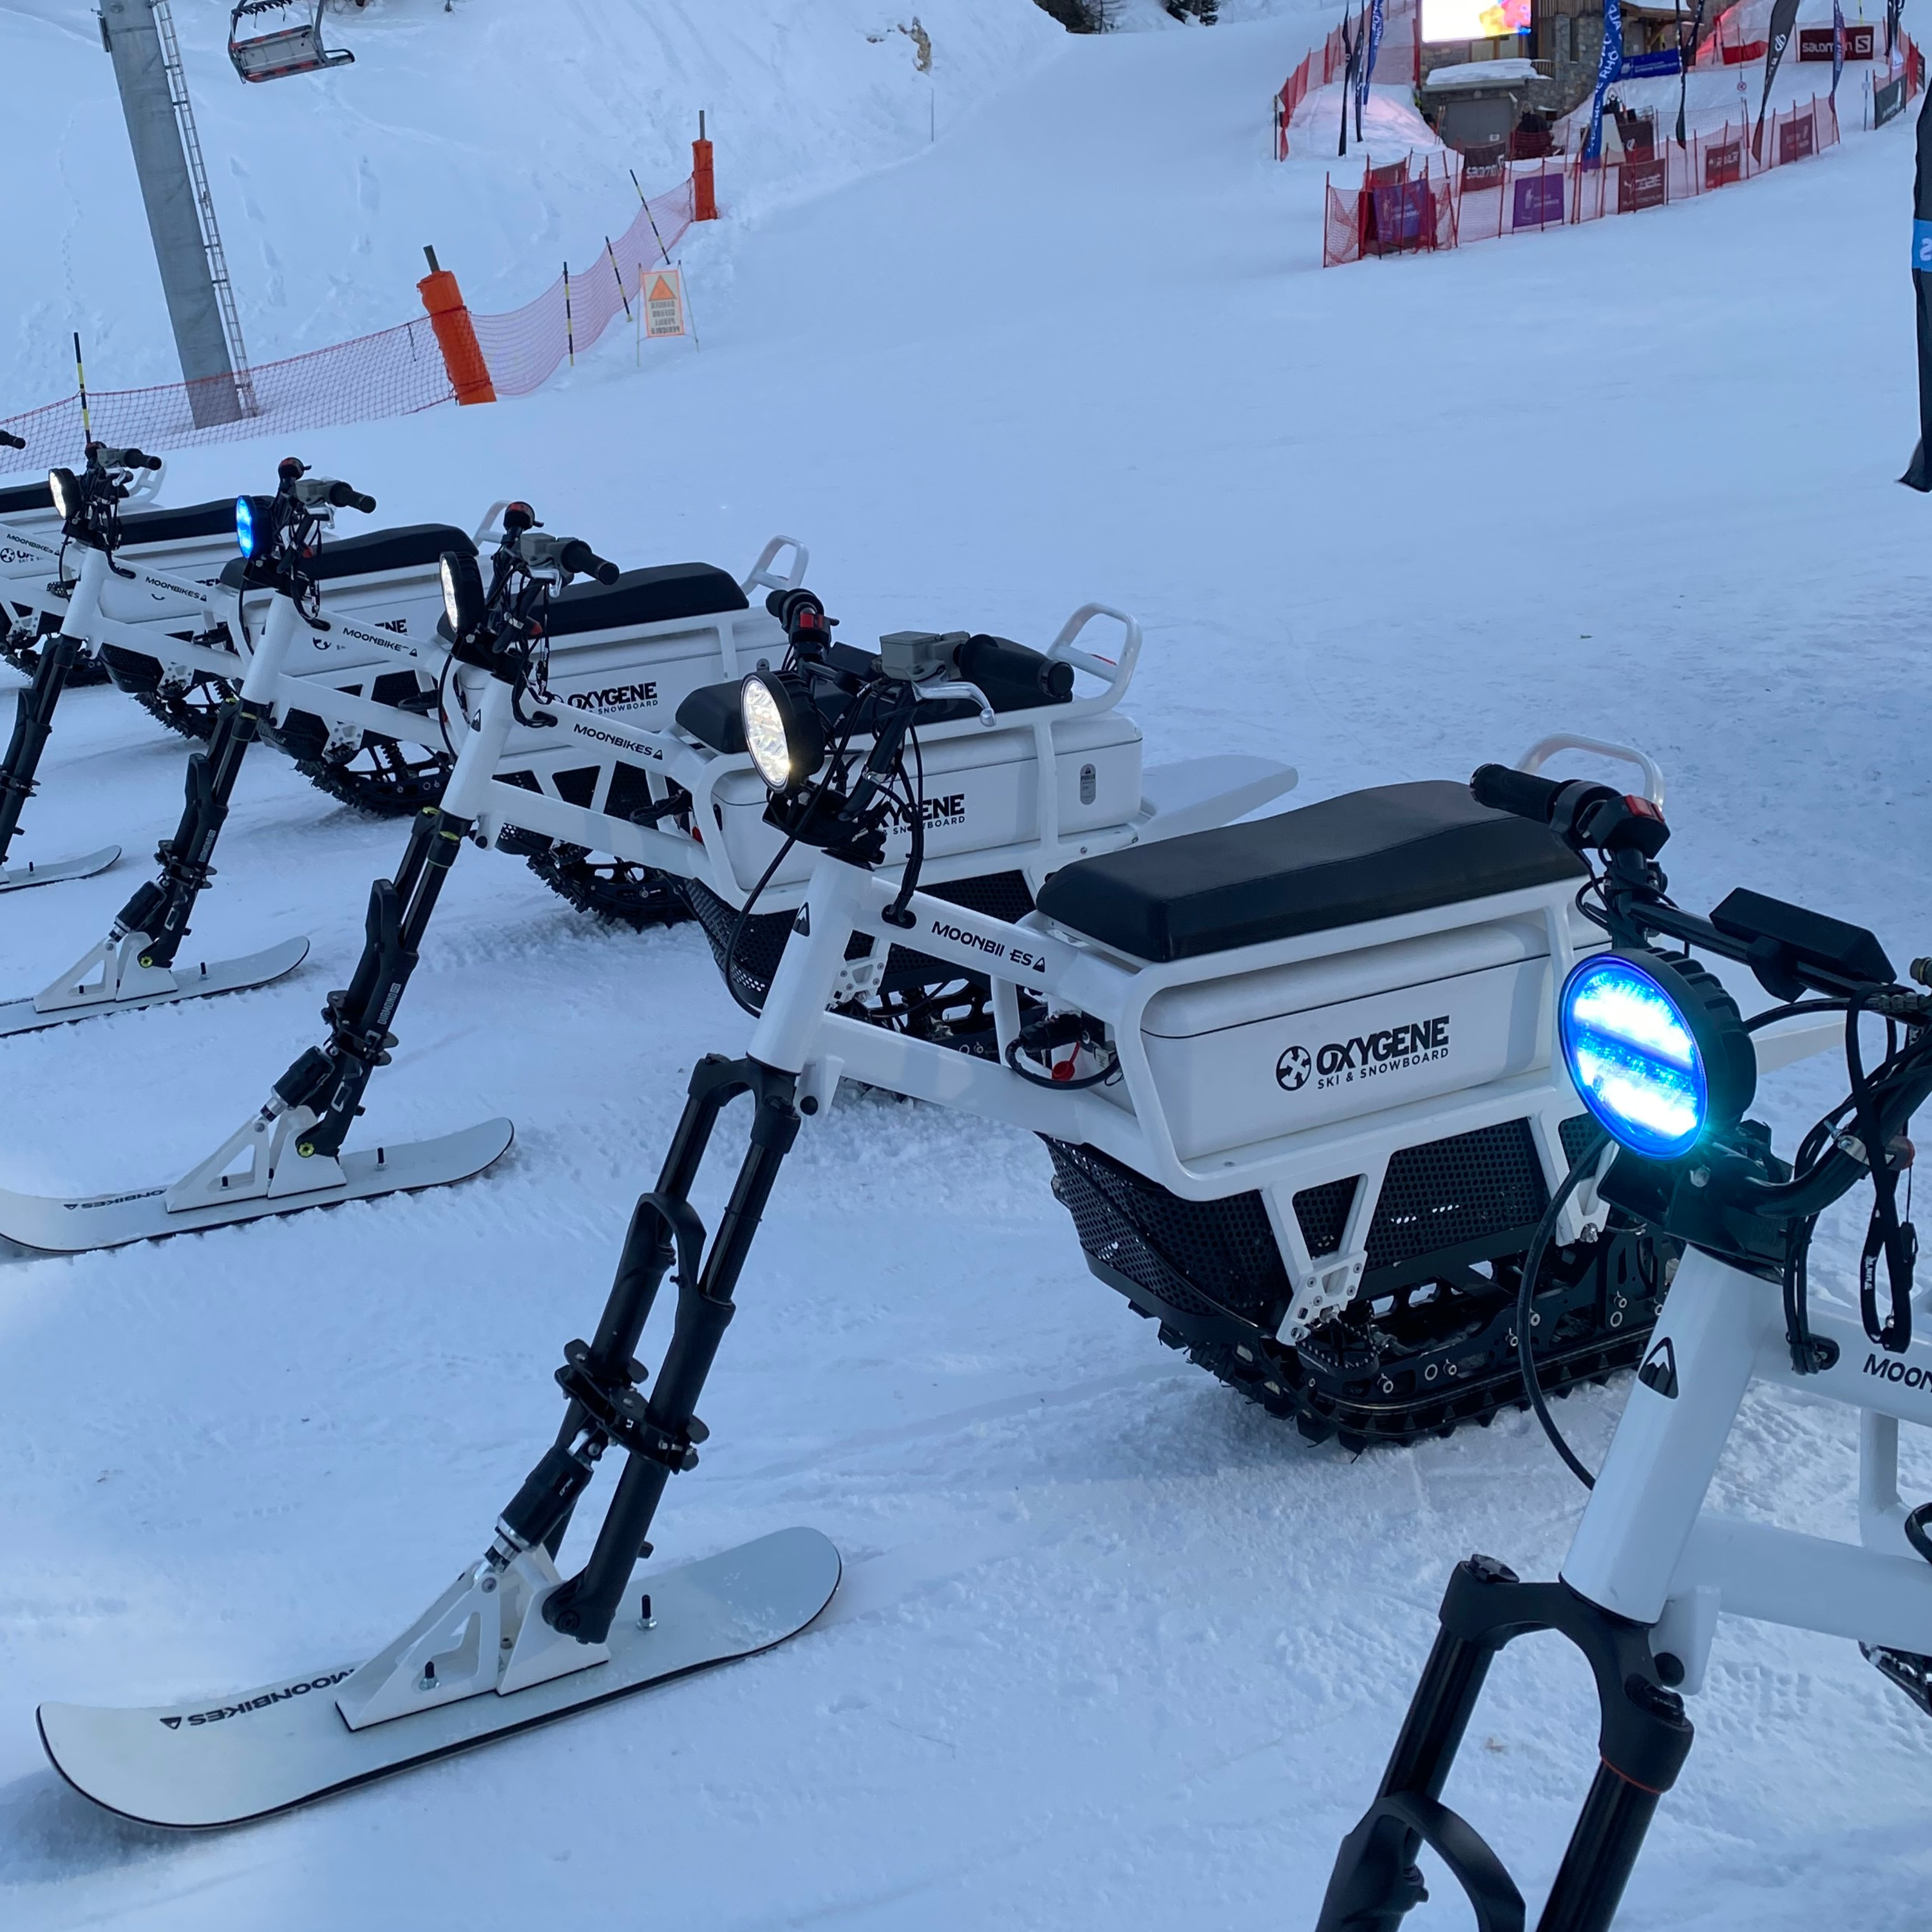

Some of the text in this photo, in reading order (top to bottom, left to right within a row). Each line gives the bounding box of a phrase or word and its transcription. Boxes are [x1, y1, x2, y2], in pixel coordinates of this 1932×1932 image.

[1802, 41, 1853, 53] salomn
[145, 576, 200, 599] MOONBIKES
[342, 627, 409, 652] MOONBIKE
[567, 681, 658, 710] OXYGENE
[598, 699, 658, 715] SNOWBOARD
[574, 723, 653, 756] MOONBIKES
[893, 816, 965, 835] SNBOARD
[377, 993, 398, 1025] DIAMOND
[1316, 1015, 1450, 1075] OXYGENE
[1317, 1048, 1448, 1090] SKI & SNOWBOARD
[82, 1189, 166, 1209] ONBIKES
